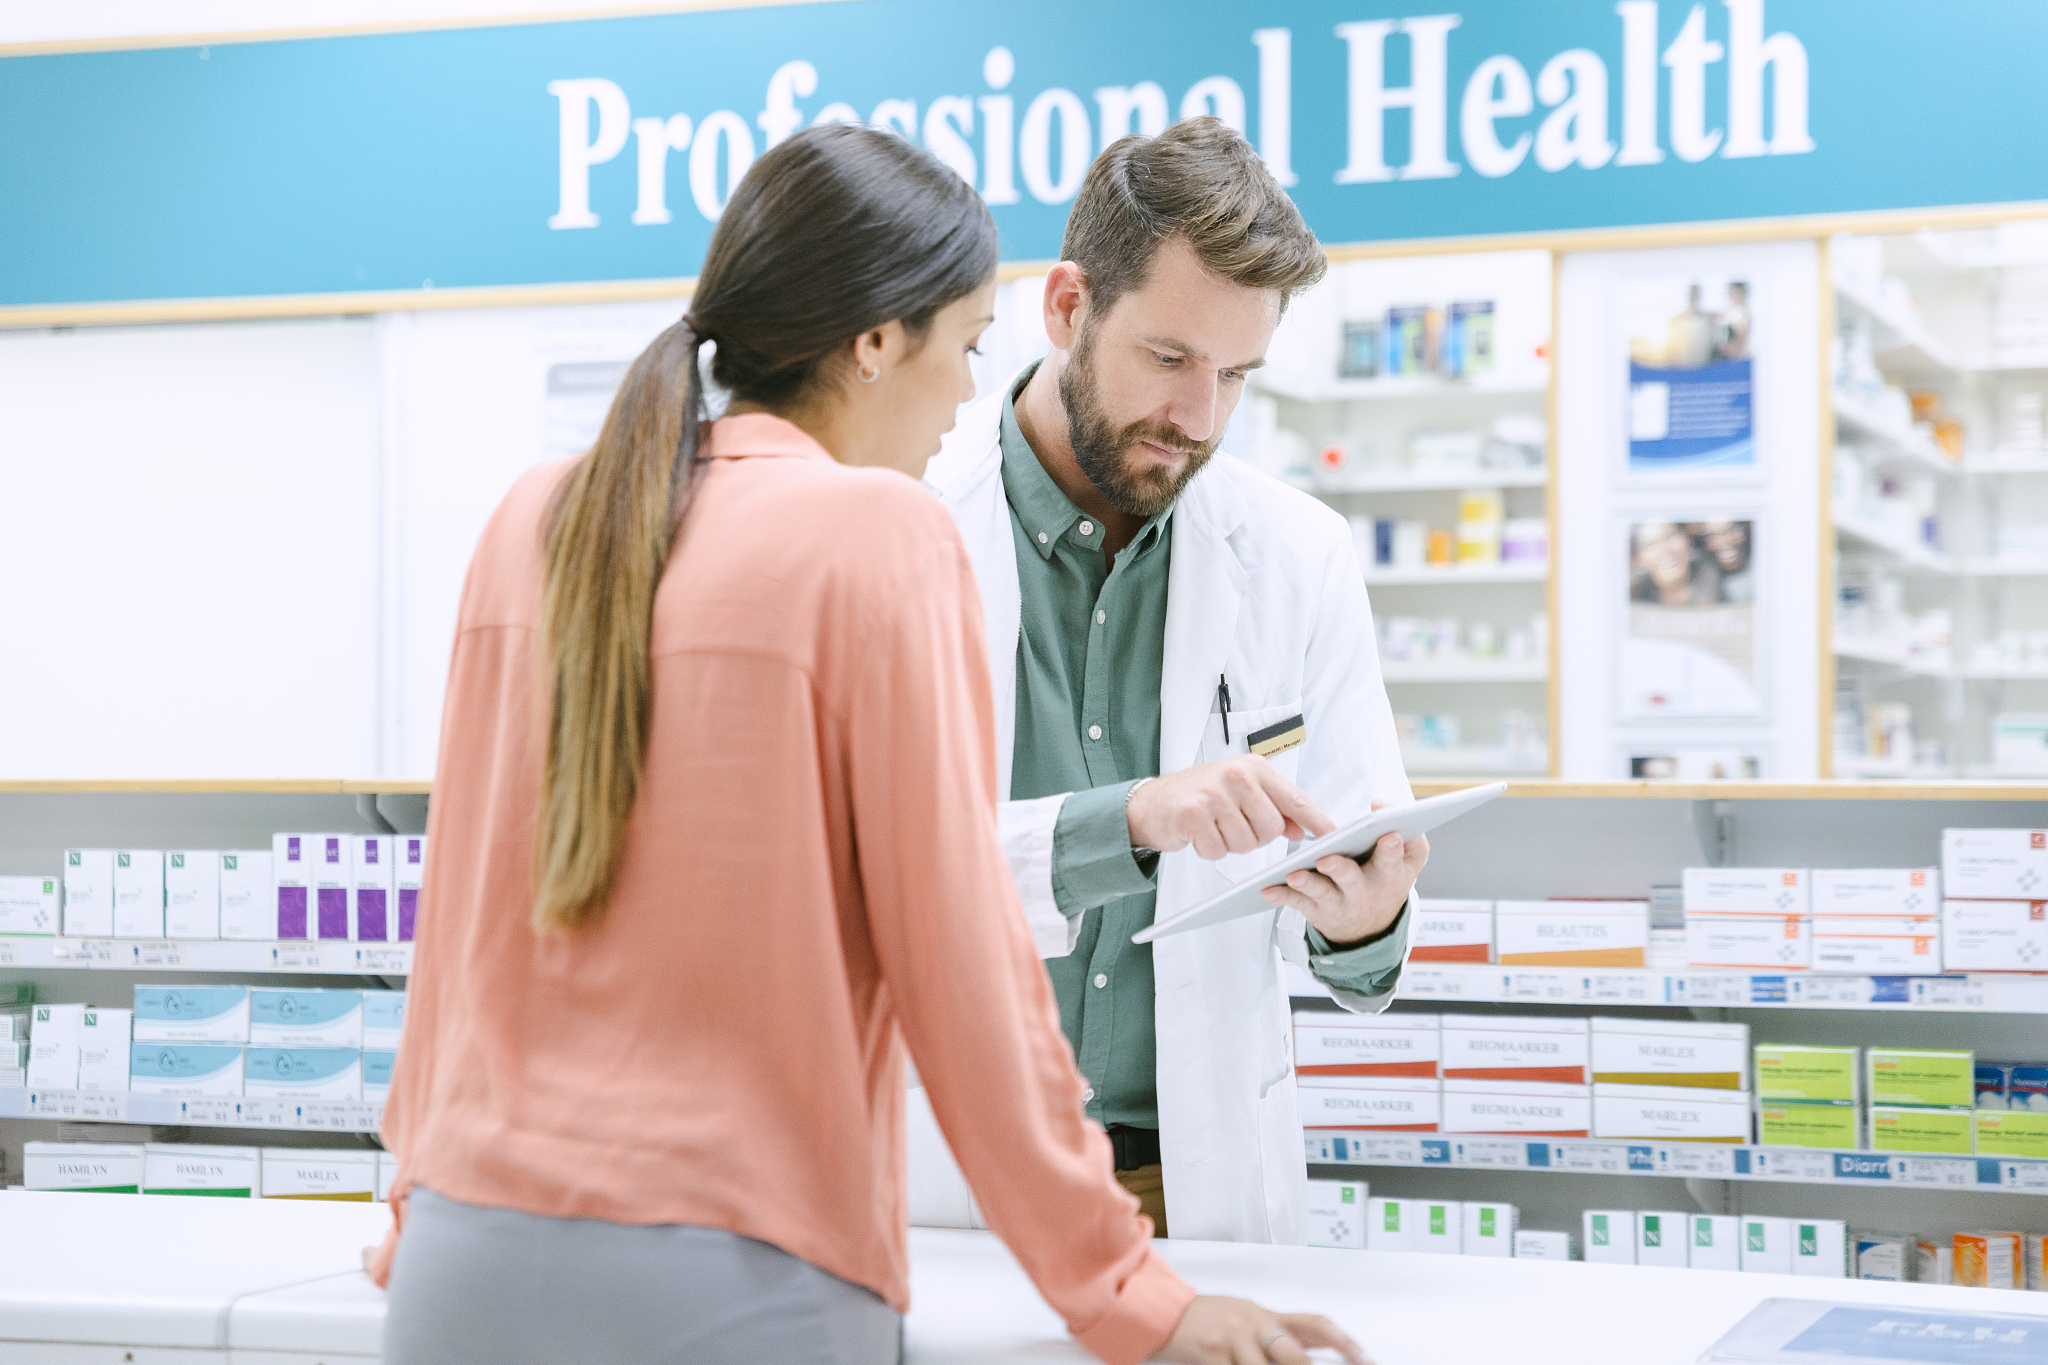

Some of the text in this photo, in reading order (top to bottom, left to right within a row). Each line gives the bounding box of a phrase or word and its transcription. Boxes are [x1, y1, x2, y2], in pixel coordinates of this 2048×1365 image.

[1334, 0, 1818, 185] Health
[70, 852, 81, 865] N
[118, 854, 130, 867] N
[172, 854, 184, 867] N
[224, 856, 237, 869] N
[1536, 924, 1608, 939] BEAUTIS
[38, 1009, 50, 1021] N
[85, 1013, 97, 1026] N
[1638, 1045, 1697, 1059] MARLEX
[1641, 1110, 1702, 1123] MARLEX
[58, 1163, 108, 1176] HAMILYN
[175, 1163, 224, 1177] HAMILYN
[296, 1169, 341, 1182] MARLEX
